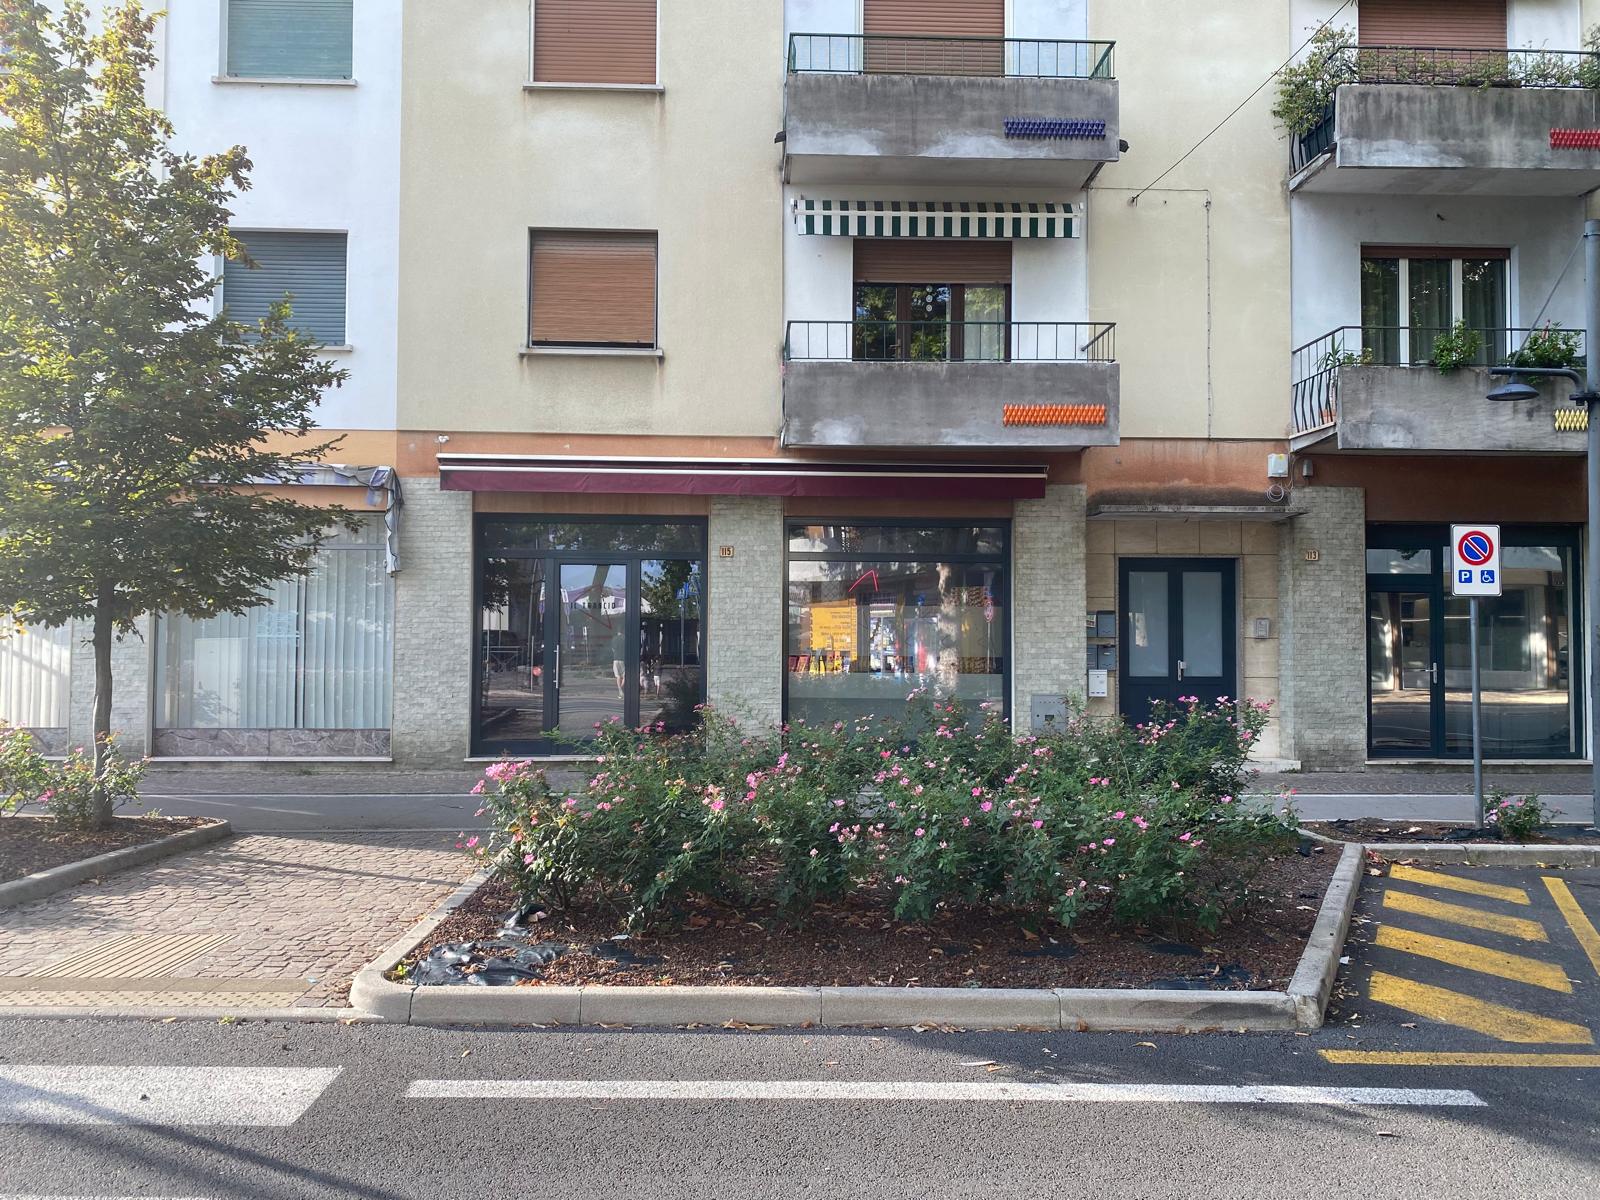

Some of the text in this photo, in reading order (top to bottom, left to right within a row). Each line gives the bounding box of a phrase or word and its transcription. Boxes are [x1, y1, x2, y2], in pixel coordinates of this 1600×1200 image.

[721, 547, 731, 556] 115
[1307, 551, 1317, 560] 113
[1461, 571, 1470, 582] P
